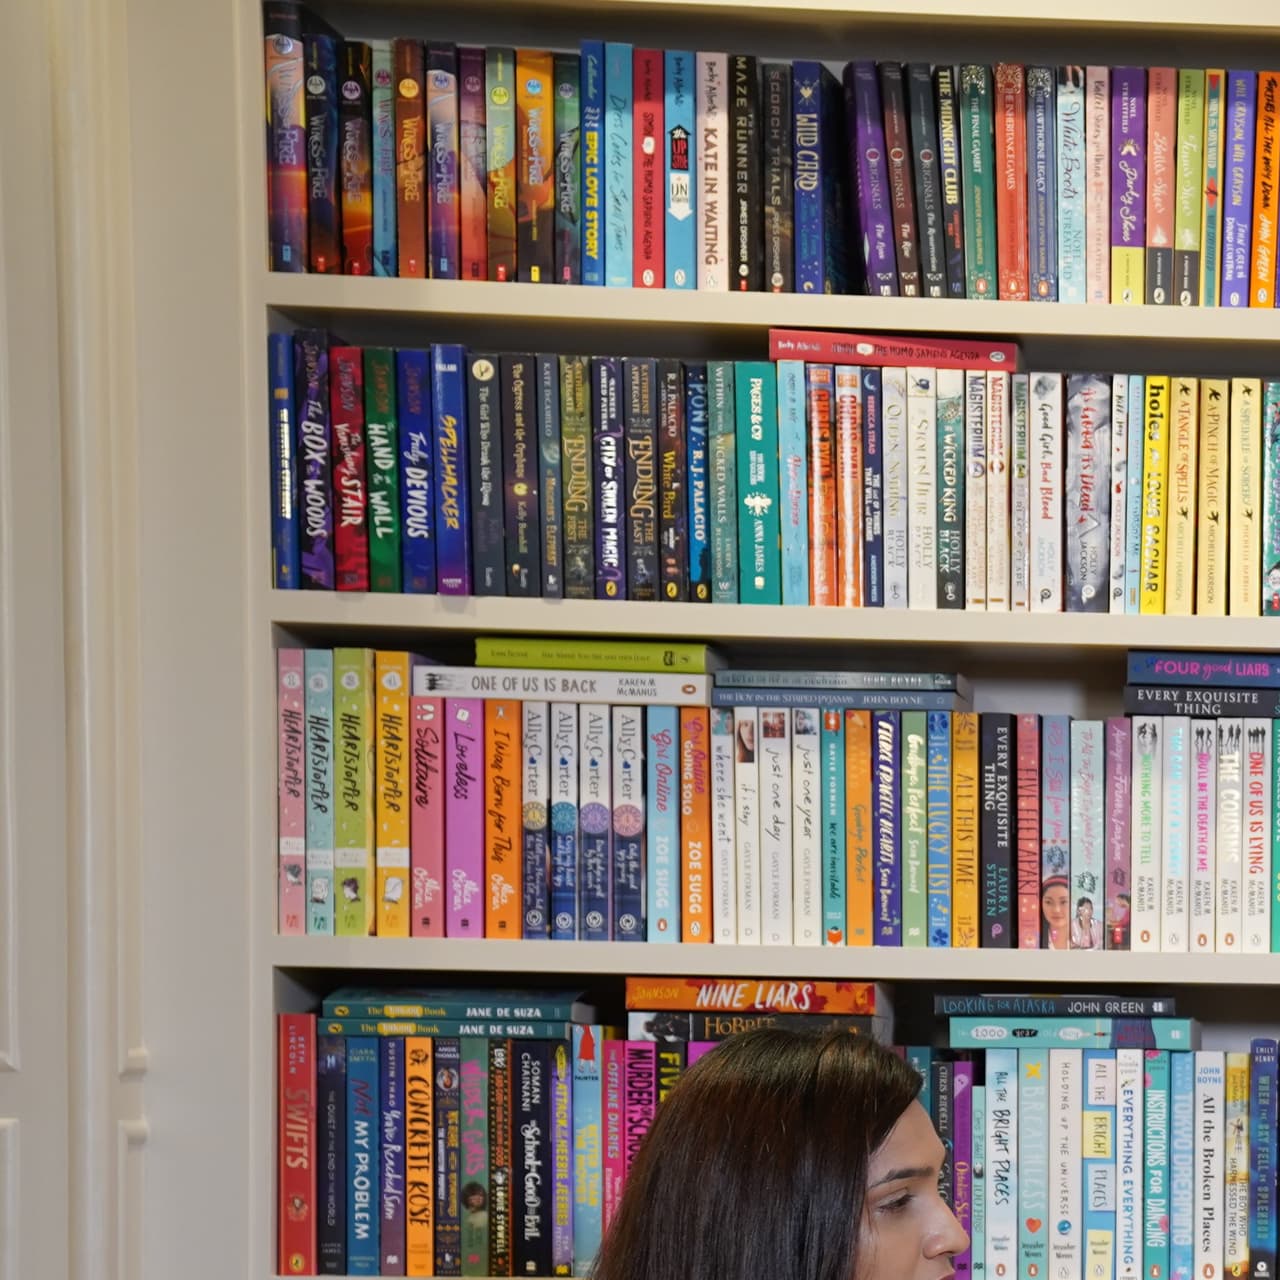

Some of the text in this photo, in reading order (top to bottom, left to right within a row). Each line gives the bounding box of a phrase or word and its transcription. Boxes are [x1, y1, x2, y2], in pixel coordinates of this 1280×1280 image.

[938, 70, 958, 204] THE MIDNIGHT CLUB
[585, 131, 598, 259] EPIC LOVE STORY
[704, 128, 718, 266] KATE IN WAITING
[1148, 384, 1164, 441] holes
[404, 432, 428, 538] Truly DEVIOUS
[439, 415, 459, 530] SPELLHACKER
[662, 450, 676, 518] White Bird
[942, 488, 957, 522] KING
[694, 481, 704, 541] PALACIO
[939, 529, 949, 572] BLACK
[950, 530, 960, 574] HOLLY
[1155, 660, 1269, 680] FOUR good LIARS
[309, 715, 330, 813] HEARTSTOPPER
[414, 726, 439, 809] Solitaire
[453, 731, 476, 800] Loveless
[984, 763, 995, 811] THING
[996, 727, 1008, 848] EVERY EXQUISITE
[697, 984, 812, 1011] NINE LIARS
[1068, 1002, 1144, 1013] JOHN GREEN
[354, 1120, 369, 1239] MY PROBLEM
[407, 1076, 430, 1226] CONCRETE ROSE
[1201, 1093, 1215, 1254] All the Broken Places
